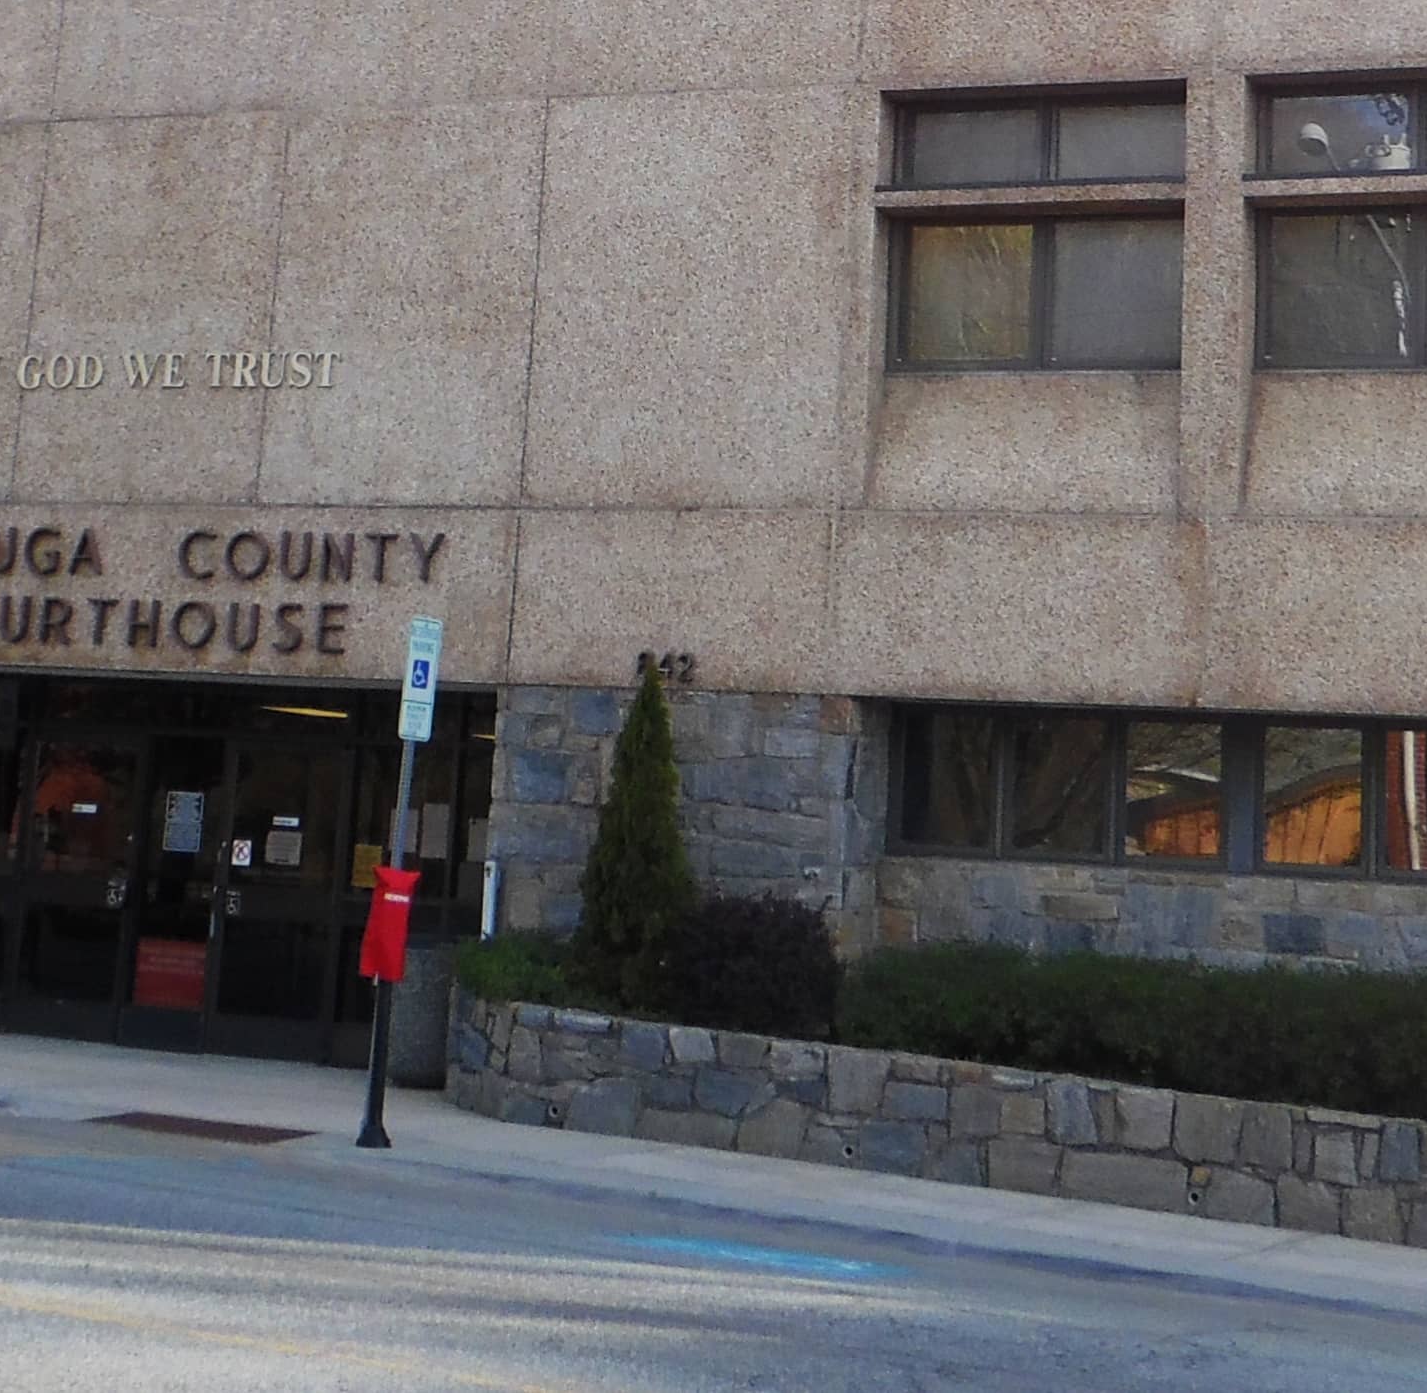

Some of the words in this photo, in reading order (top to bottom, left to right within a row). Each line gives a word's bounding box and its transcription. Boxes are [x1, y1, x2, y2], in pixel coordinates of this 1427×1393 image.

[17, 354, 104, 390] GOD
[123, 353, 186, 389] WE
[205, 351, 342, 389] TRUST
[178, 530, 446, 585] COUNTY
